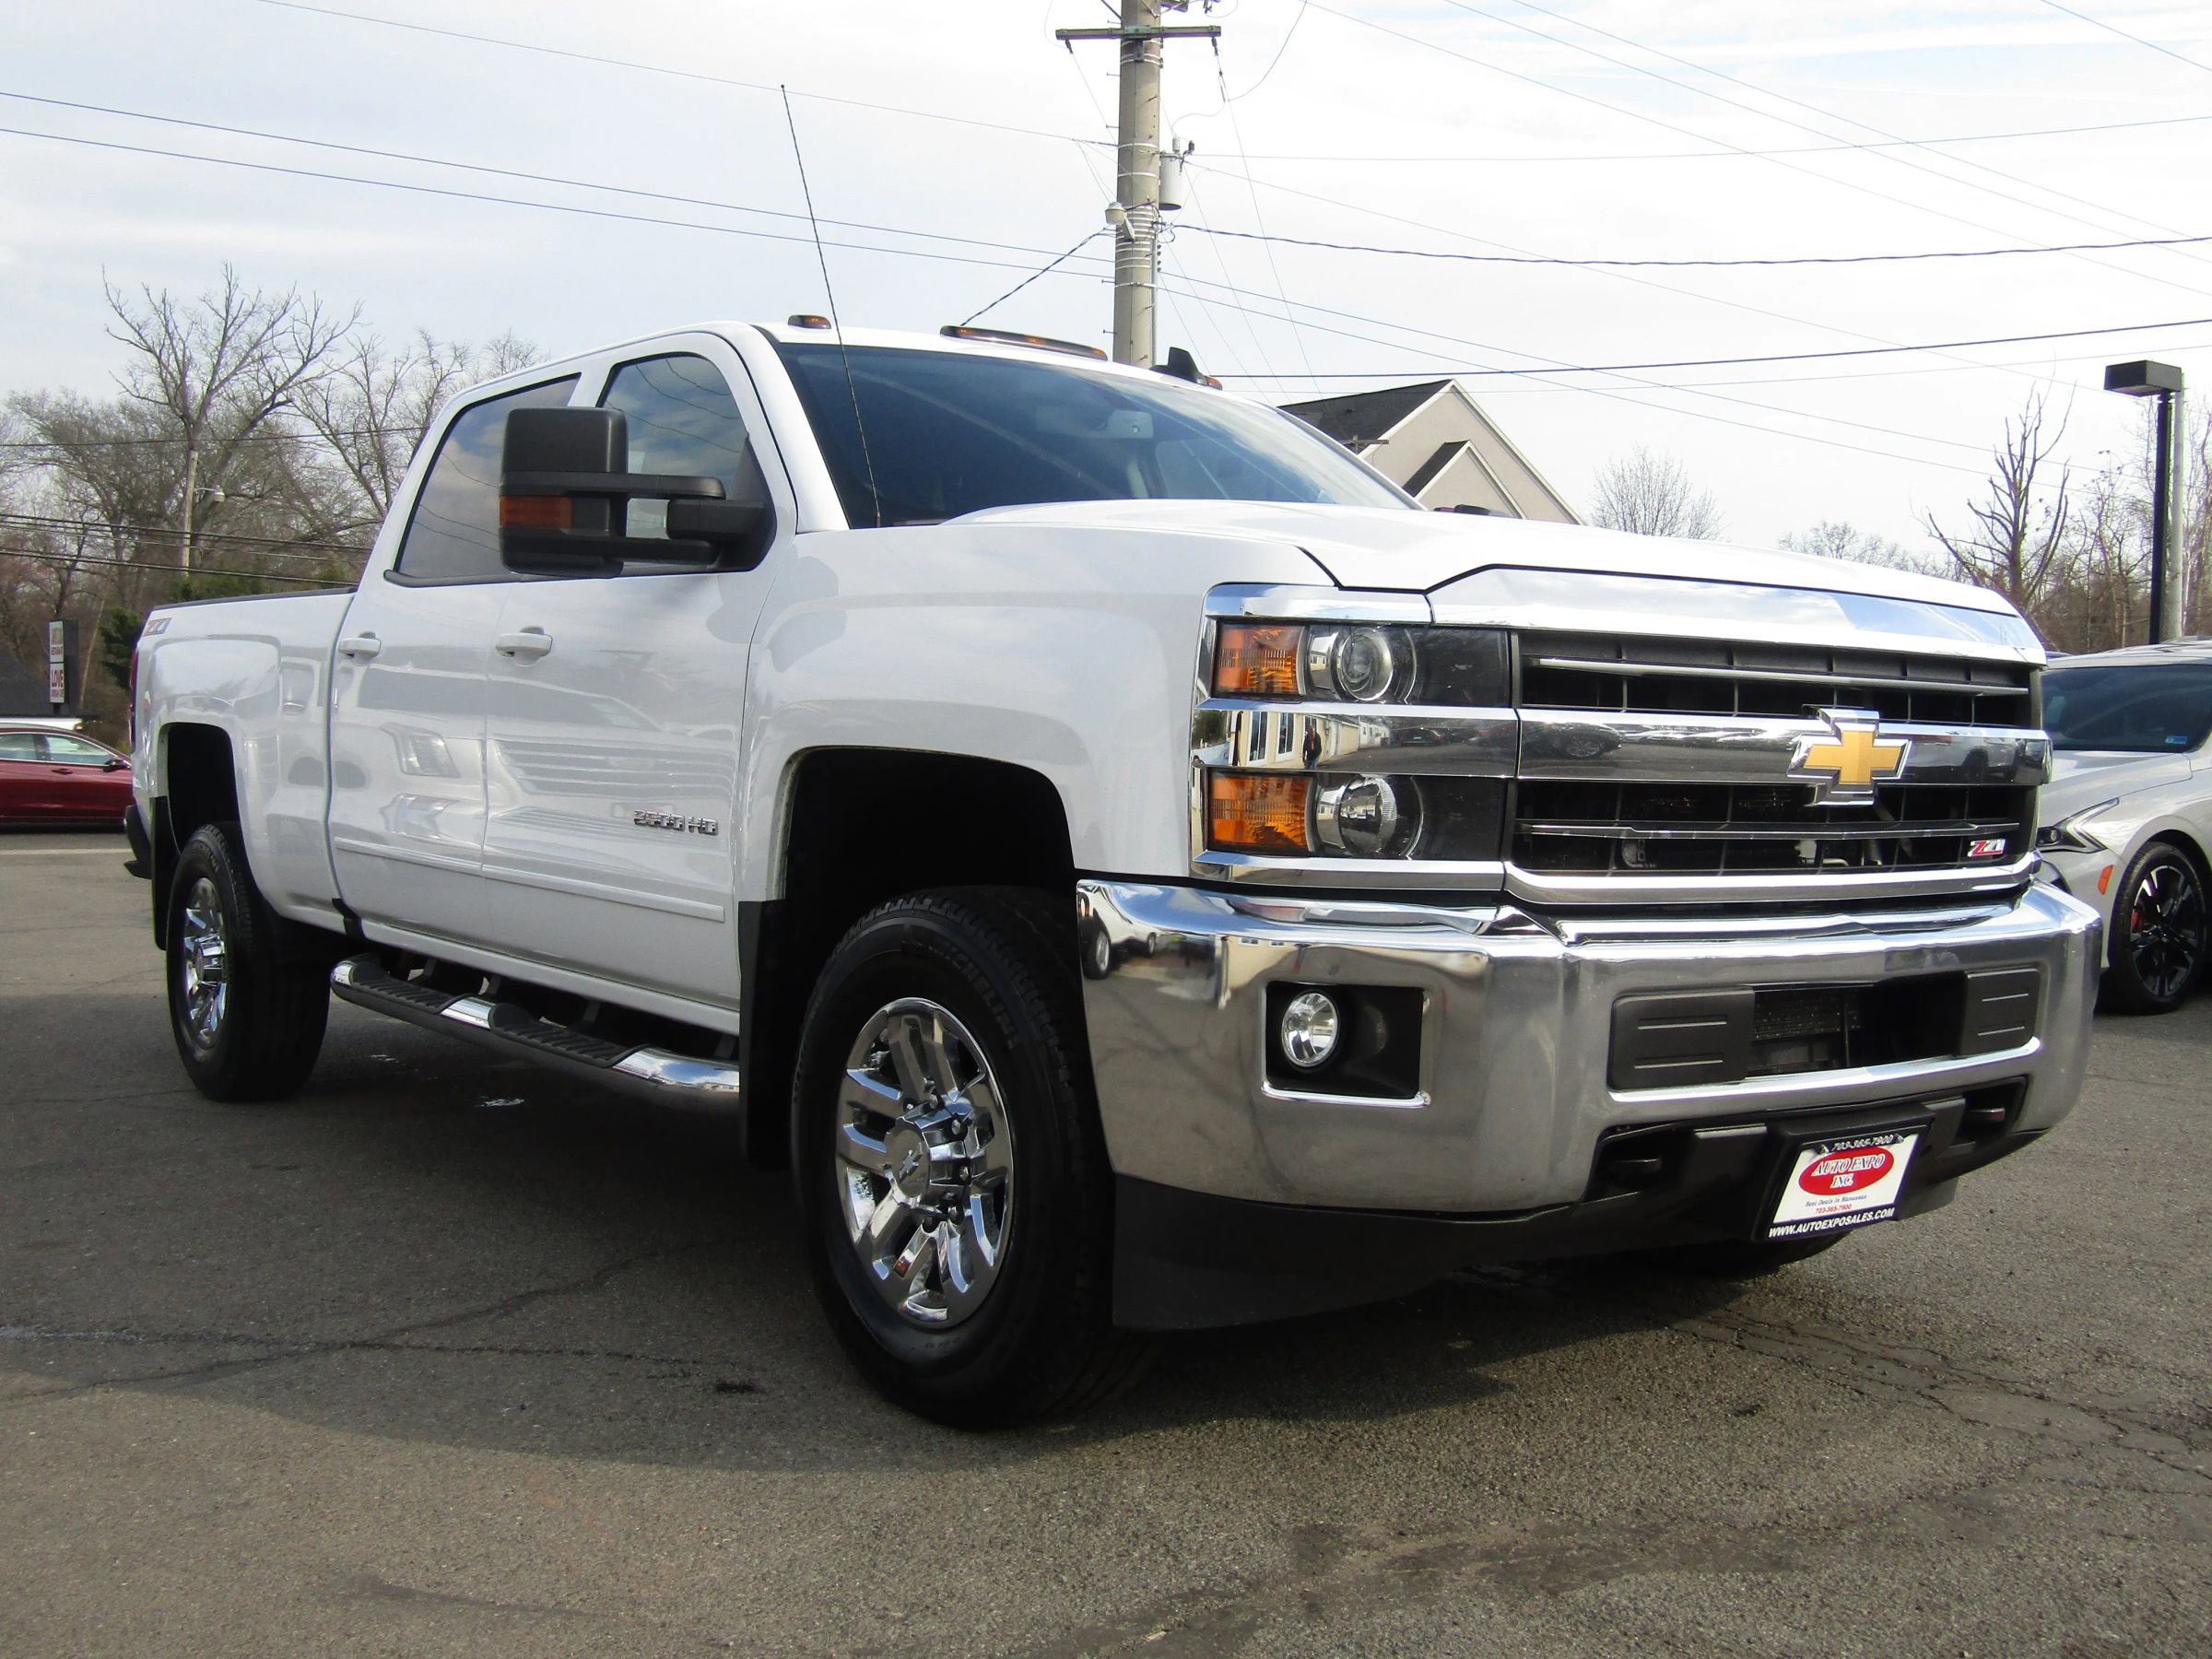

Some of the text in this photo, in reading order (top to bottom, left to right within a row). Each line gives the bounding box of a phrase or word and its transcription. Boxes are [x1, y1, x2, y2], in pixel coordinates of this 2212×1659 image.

[688, 817, 718, 836] HD
[1967, 839, 2006, 857] Z71
[1811, 1153, 1886, 1176] AUTO EXPO
[1768, 1206, 1896, 1239] WWW.AUTOEXPOSALES.COM
